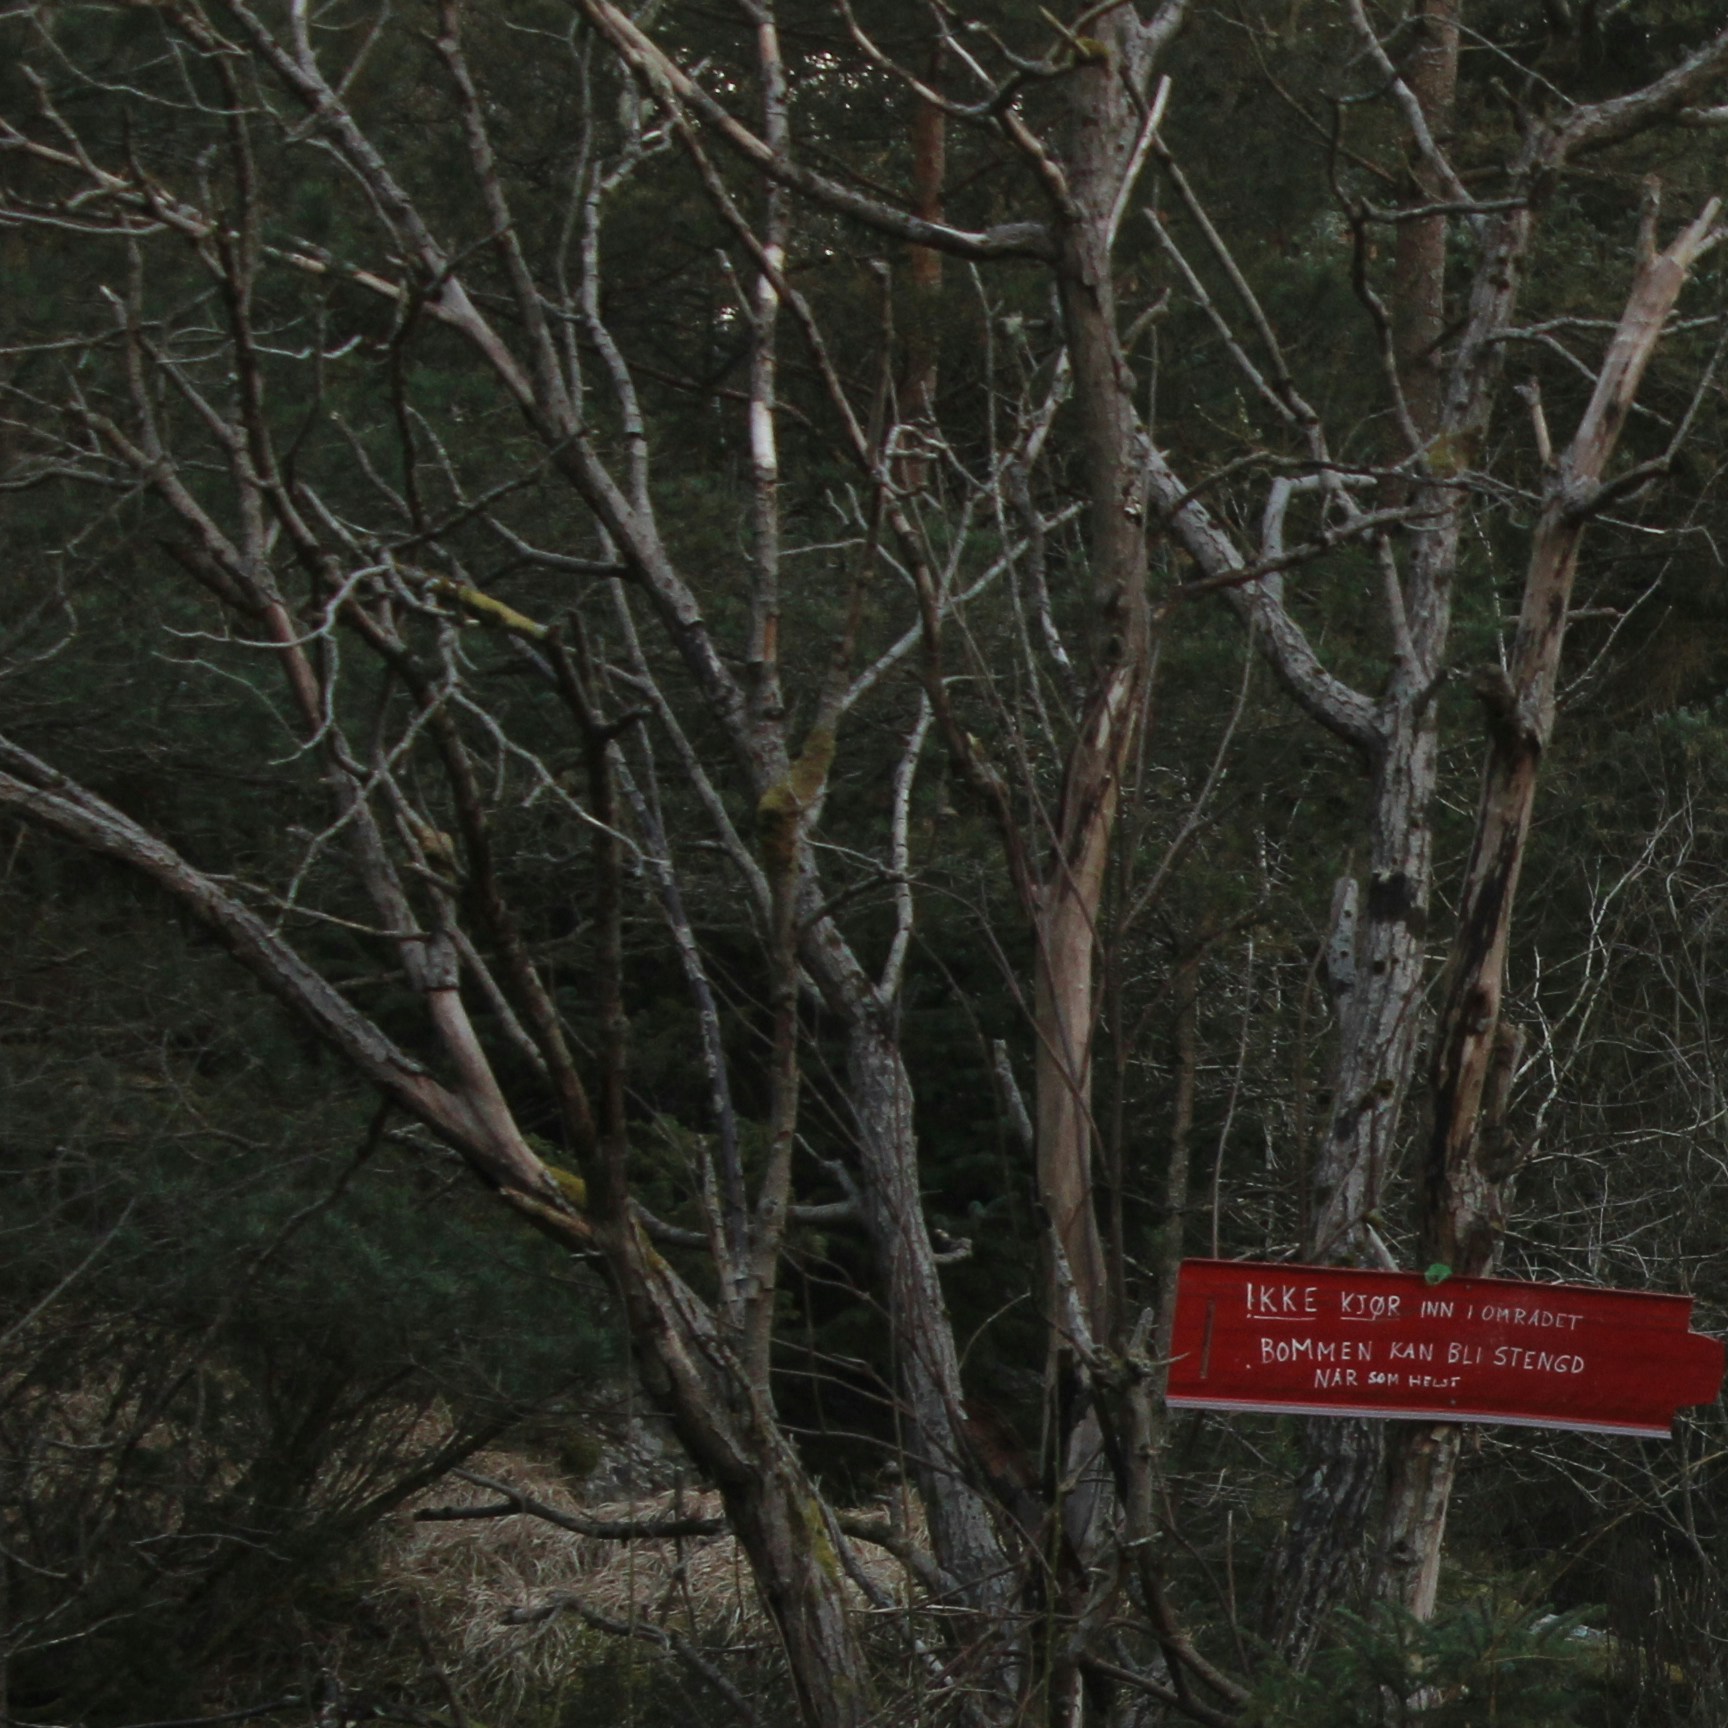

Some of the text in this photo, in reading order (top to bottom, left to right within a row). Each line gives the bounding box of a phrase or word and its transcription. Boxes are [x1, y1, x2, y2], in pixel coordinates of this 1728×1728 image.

[1246, 1282, 1318, 1312] IKKE
[1340, 1291, 1401, 1319] KJØR
[1420, 1301, 1453, 1318] INN
[1467, 1305, 1473, 1320] I
[1261, 1338, 1585, 1374] BOMMEN KAN BLI STENGD
[1368, 1371, 1399, 1386] SOM
[1408, 1374, 1461, 1388] HELST
